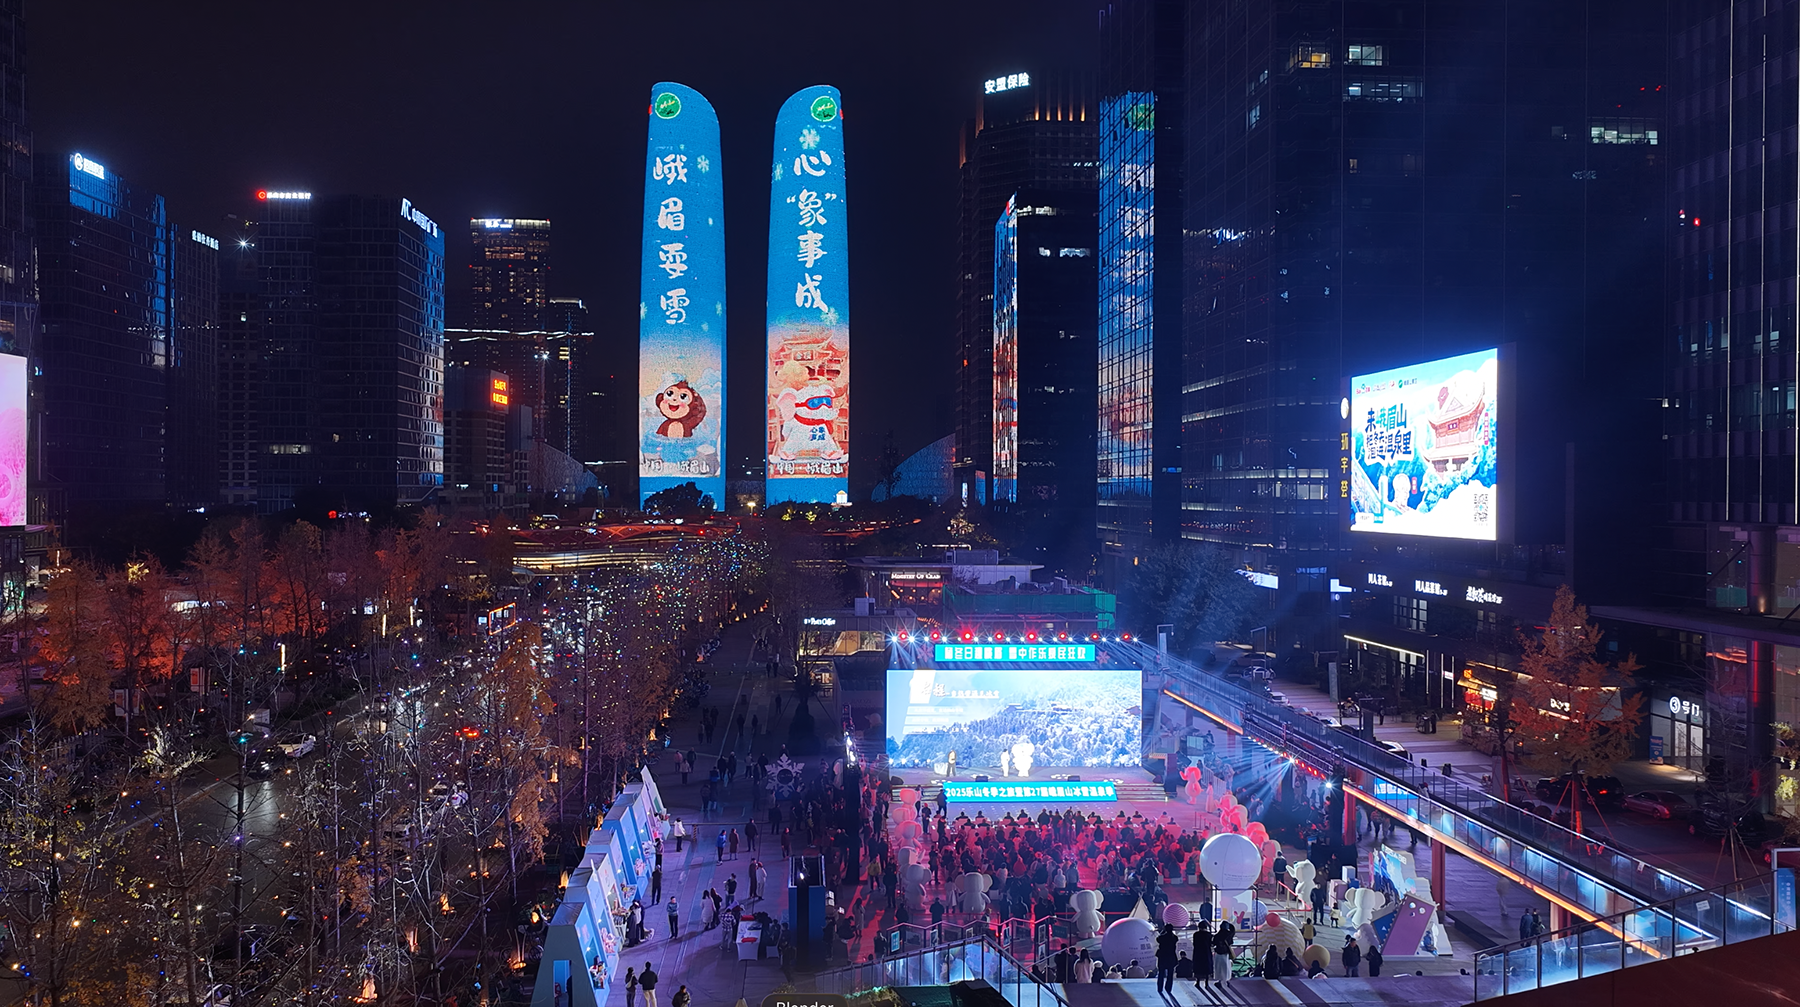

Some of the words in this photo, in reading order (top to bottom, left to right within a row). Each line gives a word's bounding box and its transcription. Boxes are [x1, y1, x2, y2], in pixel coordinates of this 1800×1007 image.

[984, 72, 1030, 94] 安盟保险
[653, 153, 690, 325] 峨眉耍雪
[1365, 402, 1407, 433] 来峨眉山
